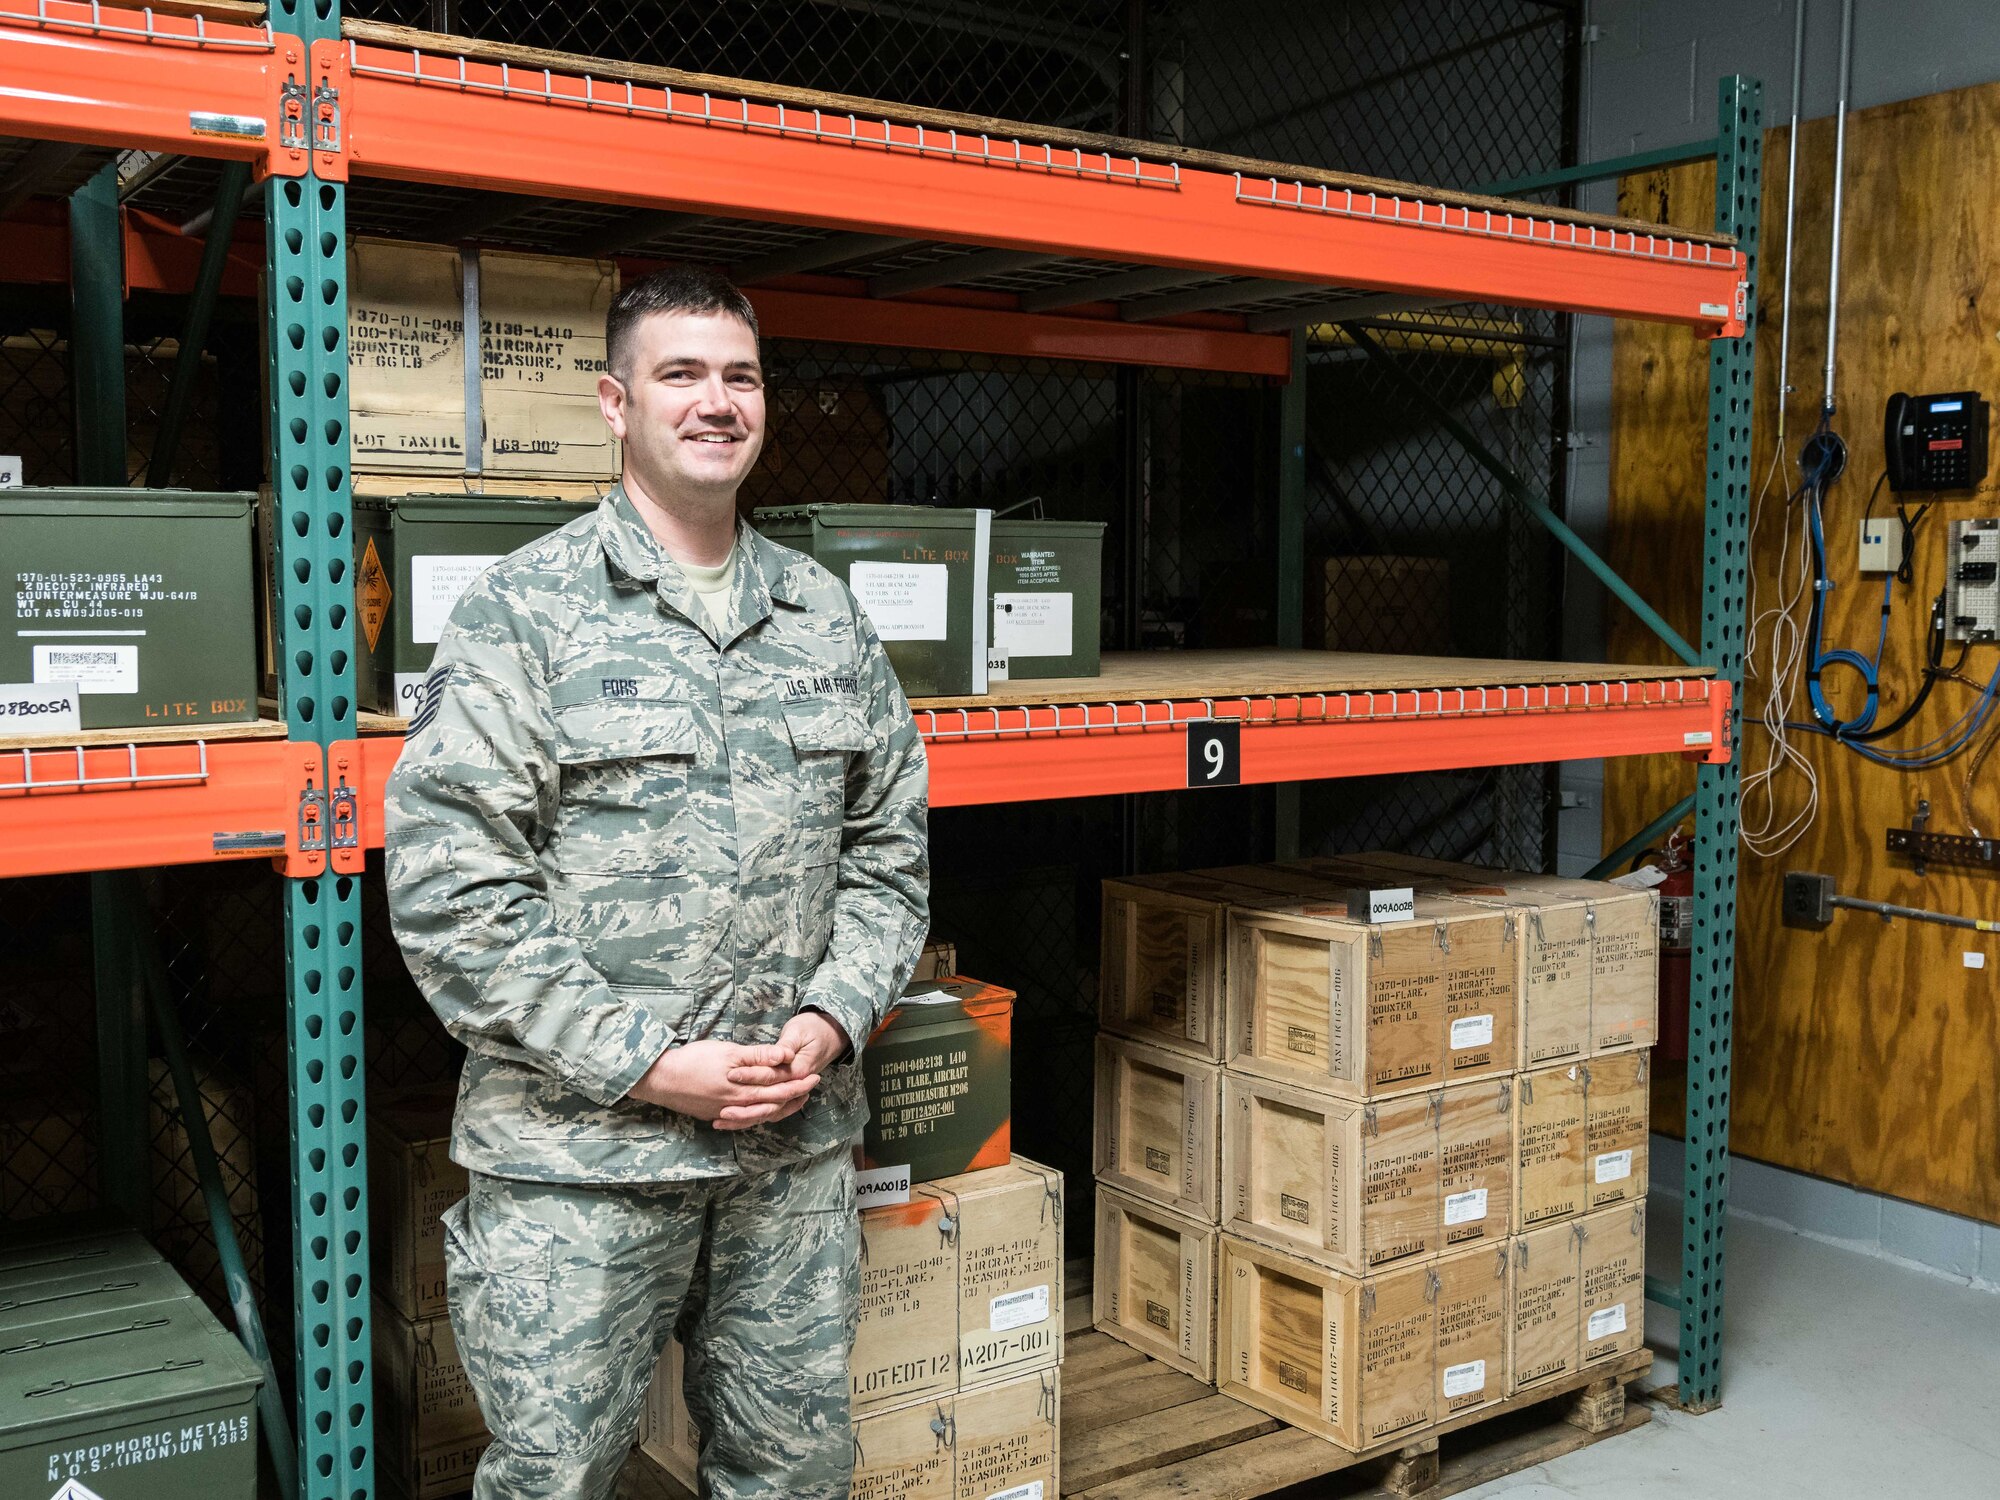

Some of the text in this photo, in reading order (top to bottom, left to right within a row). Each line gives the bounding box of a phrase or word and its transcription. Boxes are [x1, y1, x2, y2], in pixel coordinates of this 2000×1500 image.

[482, 320, 574, 340] 2138-L410
[349, 325, 565, 355] 100-FLARE, AIRCRAFT
[483, 352, 563, 371] MEASURE,
[483, 367, 504, 380] CU
[518, 370, 544, 382] 1.3
[353, 434, 386, 446] LOT
[902, 550, 969, 561] LITE BOX
[996, 554, 1018, 564] BOX
[91, 582, 149, 592] INFRARED
[134, 574, 163, 583] LA43
[16, 591, 198, 600] COUNTERMEASURE MJU-64/B
[17, 600, 35, 609] WT
[63, 600, 79, 609] CU
[16, 608, 40, 618] LOT
[601, 678, 638, 698] FORS
[786, 680, 810, 696] U.S.
[813, 678, 833, 694] AIR
[146, 699, 248, 717] LITE BOX
[1204, 738, 1224, 780] 9
[1532, 962, 1566, 974] COUNTER
[1372, 1001, 1412, 1015] COUNTER
[880, 1051, 966, 1077] 1370-01-048-2138 L410
[880, 1066, 968, 1093] 31 EA FLARE, AIRCRAFT
[1376, 1070, 1392, 1082] LOT
[880, 1082, 968, 1109] COUNTERMEASURE M206
[880, 1100, 955, 1126] LOT: EDT12A207-001
[881, 1123, 926, 1142] WT: 20 CU:
[1520, 1144, 1556, 1158] COUNTER
[1367, 1178, 1406, 1194] COUNTER
[1370, 1252, 1386, 1263] LOT
[864, 1256, 952, 1282] 370-01-048-
[862, 1272, 934, 1295] 00-FLARE,
[904, 1300, 920, 1312] LB
[1517, 1302, 1552, 1322] COUNTER
[964, 1330, 1050, 1368] A207-001
[1366, 1342, 1405, 1362] COUNTER
[48, 1415, 249, 1468] PYROPHORIC METALS
[212, 1428, 248, 1448] 1383
[962, 1485, 974, 1498] CU
